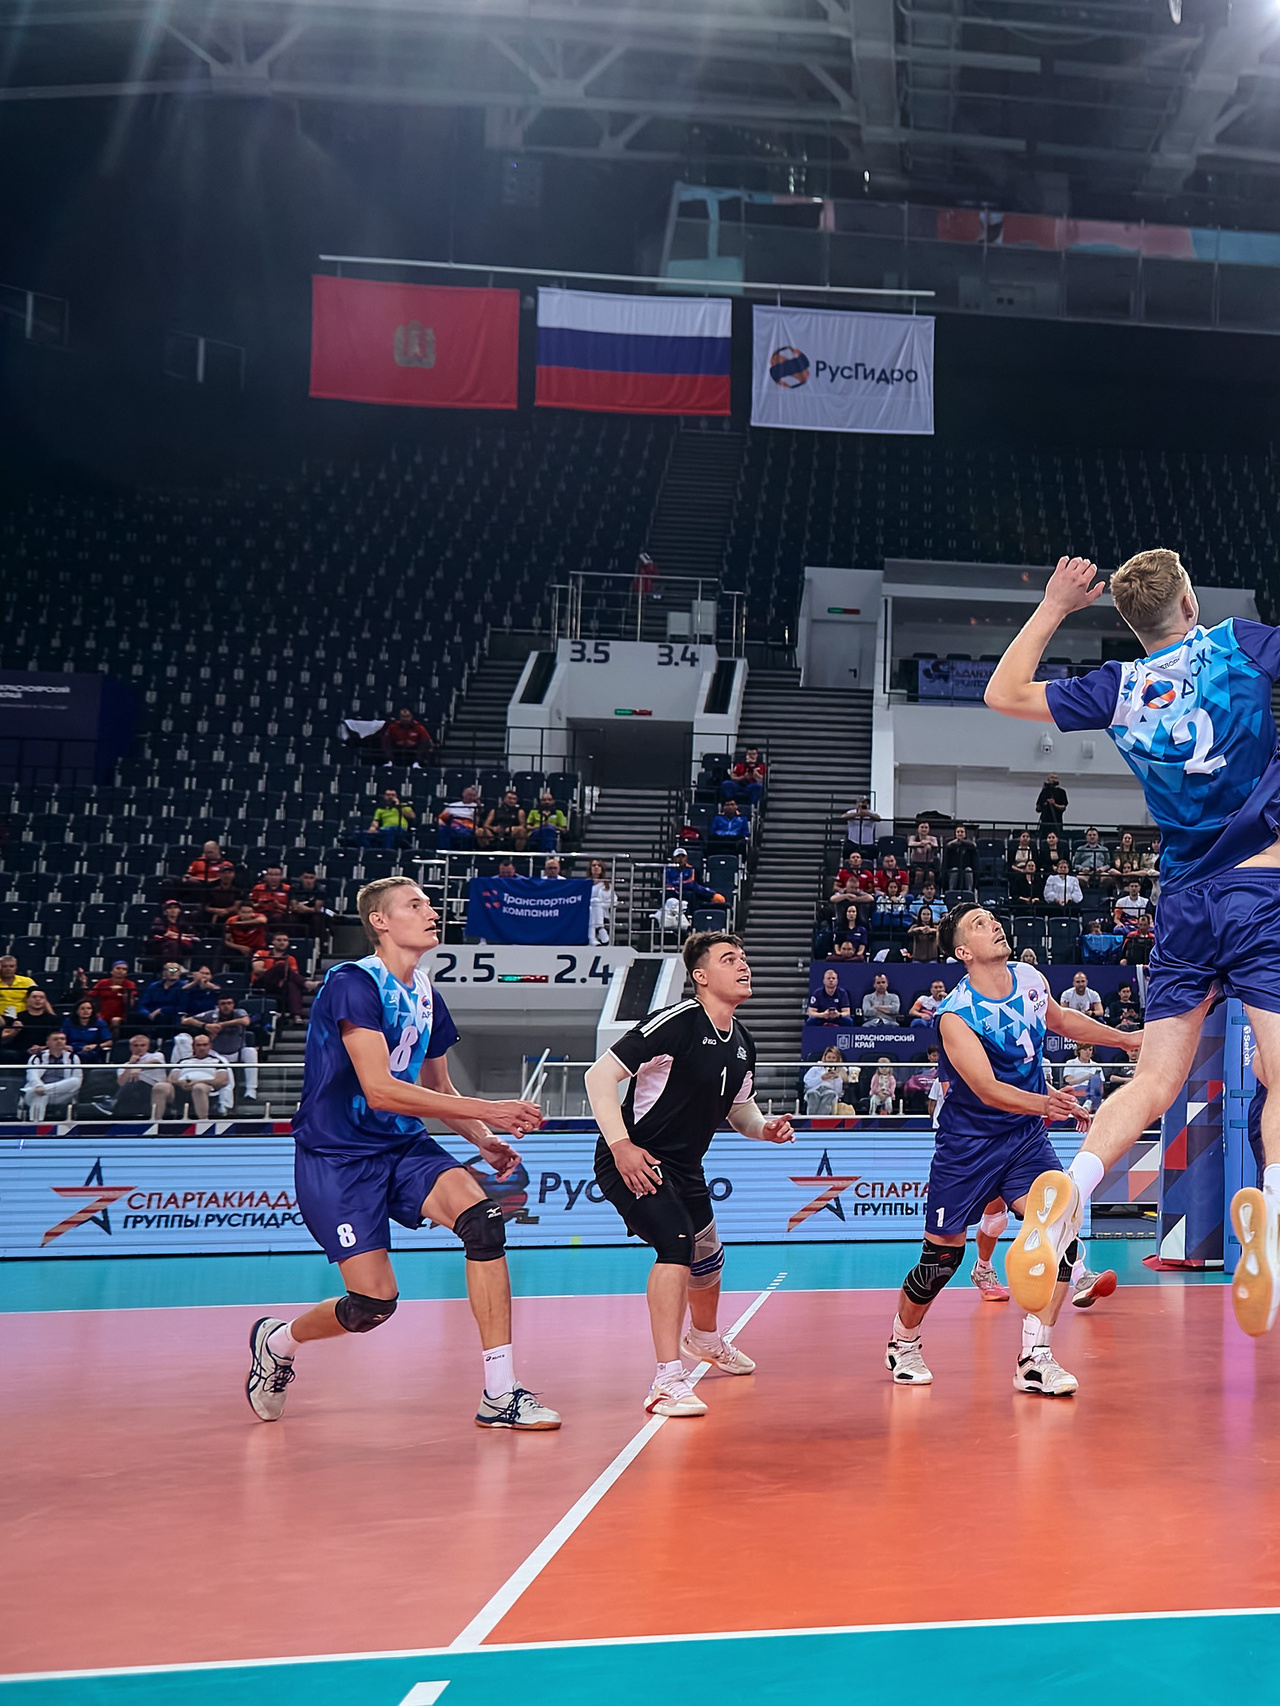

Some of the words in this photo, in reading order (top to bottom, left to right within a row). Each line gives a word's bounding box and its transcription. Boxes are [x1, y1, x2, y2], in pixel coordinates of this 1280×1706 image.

[815, 360, 918, 385] РусГидро
[570, 641, 610, 664] 3.5
[657, 644, 699, 667] 3.4
[1172, 708, 1228, 775] 2
[503, 905, 559, 918] компания
[434, 953, 495, 983] 2.5
[554, 954, 614, 985] 2.4
[389, 1025, 418, 1072] 8
[854, 1034, 915, 1042] КРАСНОЯРСКИЙ
[854, 1041, 875, 1049] КРАЙ
[1016, 1028, 1036, 1064] 1
[720, 1066, 727, 1097] 1
[854, 1182, 929, 1198] СПАРТА
[123, 1214, 200, 1229] ГРУППЫ
[204, 1212, 304, 1229] РУСГИДРО
[854, 1203, 918, 1216] ГРУППЫ
[936, 1207, 945, 1228] 1
[337, 1223, 357, 1248] 8
